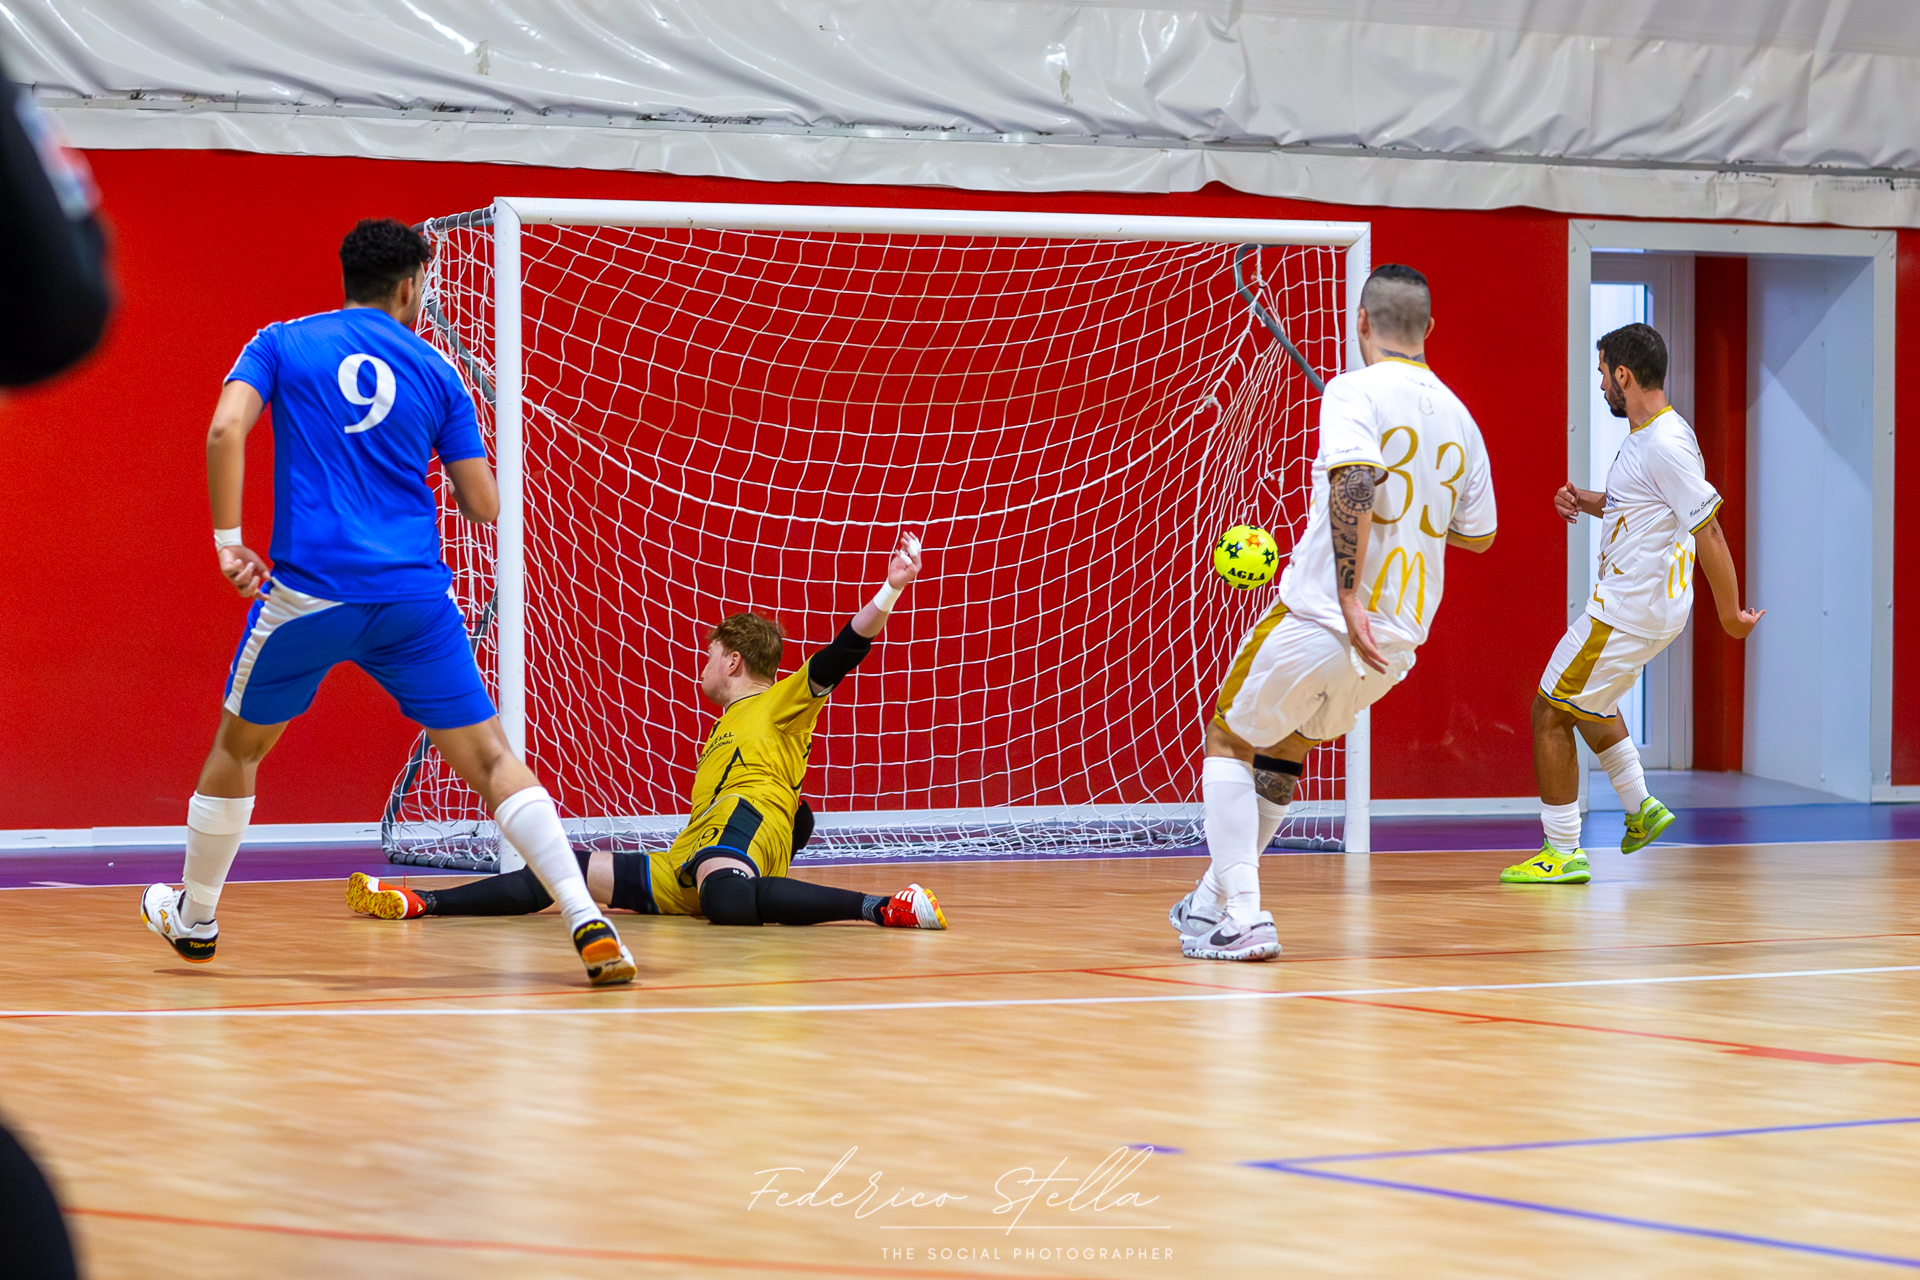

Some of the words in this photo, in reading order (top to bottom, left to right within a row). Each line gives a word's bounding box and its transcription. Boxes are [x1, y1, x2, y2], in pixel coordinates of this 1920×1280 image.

[338, 353, 396, 434] 9
[1371, 426, 1465, 538] 33
[1228, 567, 1265, 581] AGLA
